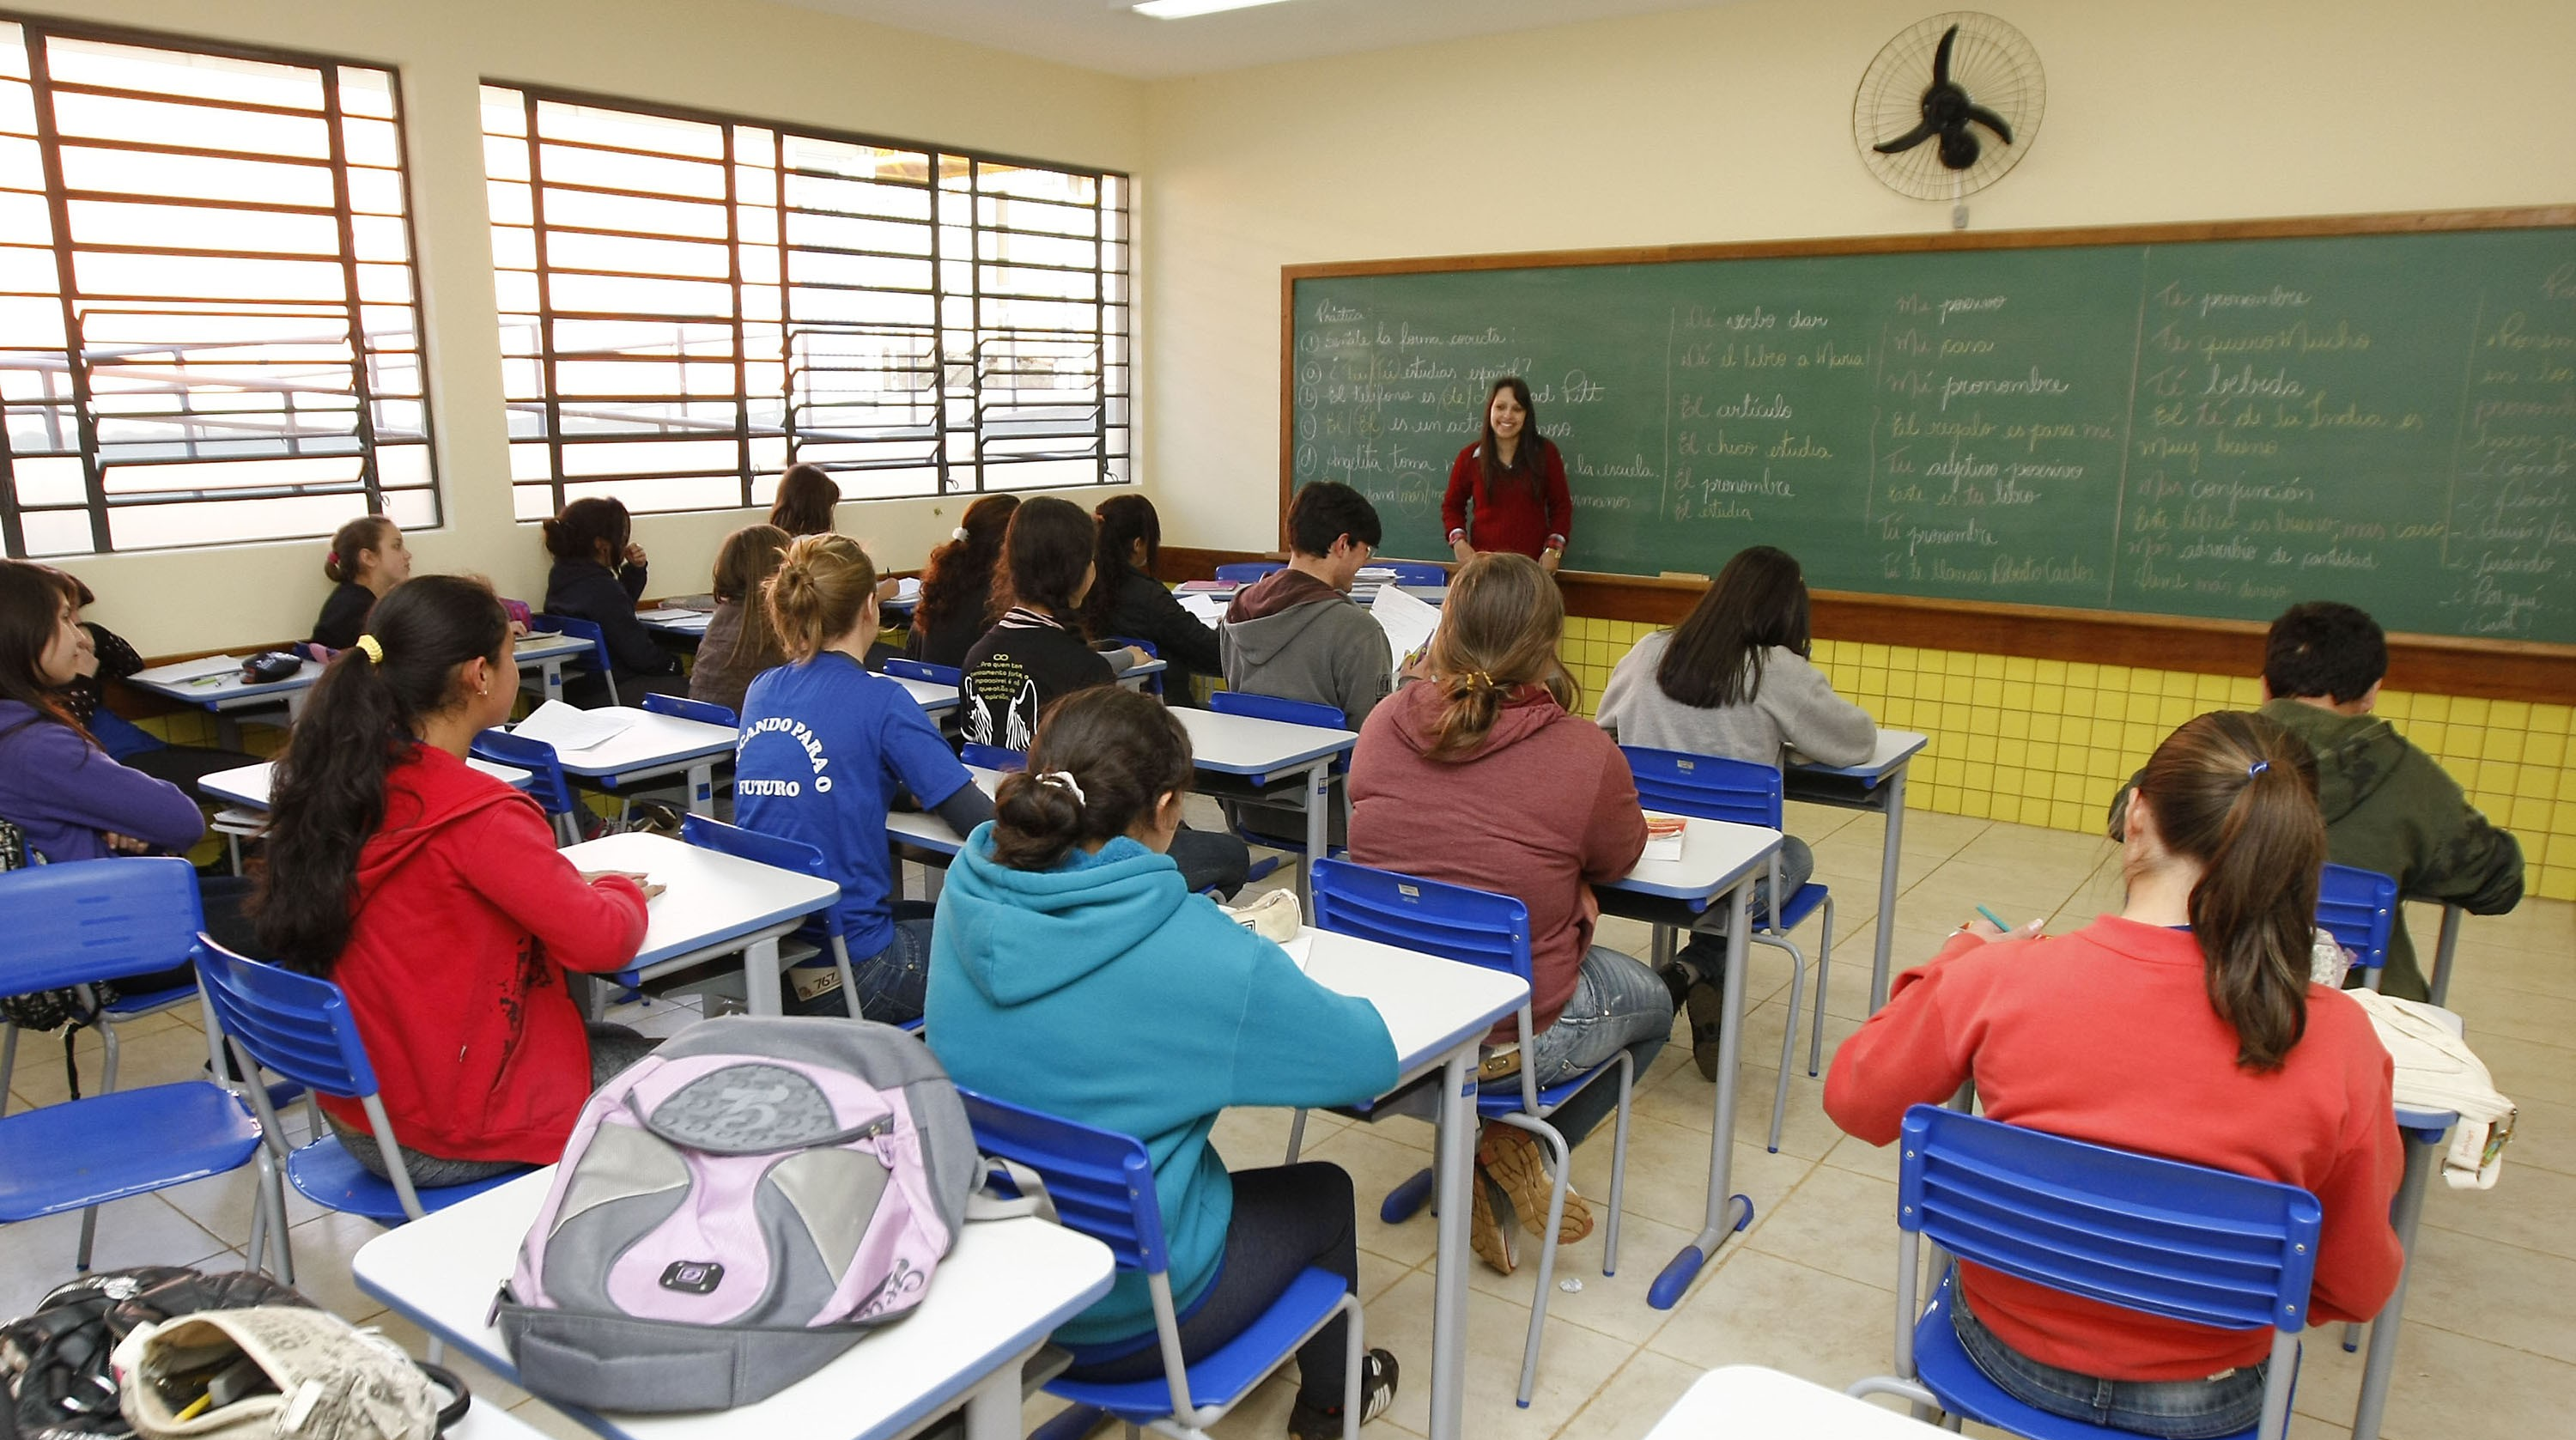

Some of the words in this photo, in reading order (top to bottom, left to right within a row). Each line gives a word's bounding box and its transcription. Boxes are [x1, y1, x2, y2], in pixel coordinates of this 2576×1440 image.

[1895, 292, 1933, 317] Mi
[2153, 280, 2195, 307] Te
[2200, 283, 2312, 318] pronombre
[1726, 305, 1777, 330] verbo
[1789, 309, 1829, 329] dar
[1376, 321, 1392, 344] la
[1401, 321, 1443, 354] forma
[1893, 328, 1931, 358] Mi
[2150, 319, 2191, 354] Te
[1402, 355, 1456, 380] estudias
[1744, 343, 1788, 368] libro
[1796, 355, 1810, 368] a
[1420, 392, 1435, 404] es
[1561, 368, 1607, 404] Pitt
[1940, 364, 2070, 412] pronombre
[2198, 362, 2306, 398] bebida
[1680, 393, 1710, 419] El
[1716, 392, 1795, 419] artículo
[2148, 401, 2189, 428] El
[2234, 403, 2262, 427] de
[2273, 403, 2303, 428] la
[2394, 411, 2423, 429] es
[1387, 416, 1407, 432] es
[1411, 419, 1442, 433] un
[1891, 411, 1920, 439] El
[2002, 422, 2023, 440] es
[2025, 421, 2075, 454] para
[1765, 428, 1834, 460] estudia
[2213, 429, 2279, 456] bueno
[1387, 444, 1437, 473] toma
[1576, 453, 1595, 477] la
[1703, 467, 1796, 505] pronombre
[1962, 483, 1986, 507] tu
[1990, 478, 2043, 505] libro
[1698, 498, 1755, 521] estudia
[2178, 505, 2239, 532] libro
[2248, 518, 2270, 534] es
[1906, 517, 1999, 557] pronombre
[2266, 545, 2293, 565] de
[790, 721, 829, 775] PARA
[815, 775, 832, 793] O
[738, 779, 800, 798] FUTURO
[814, 972, 835, 989] 767
